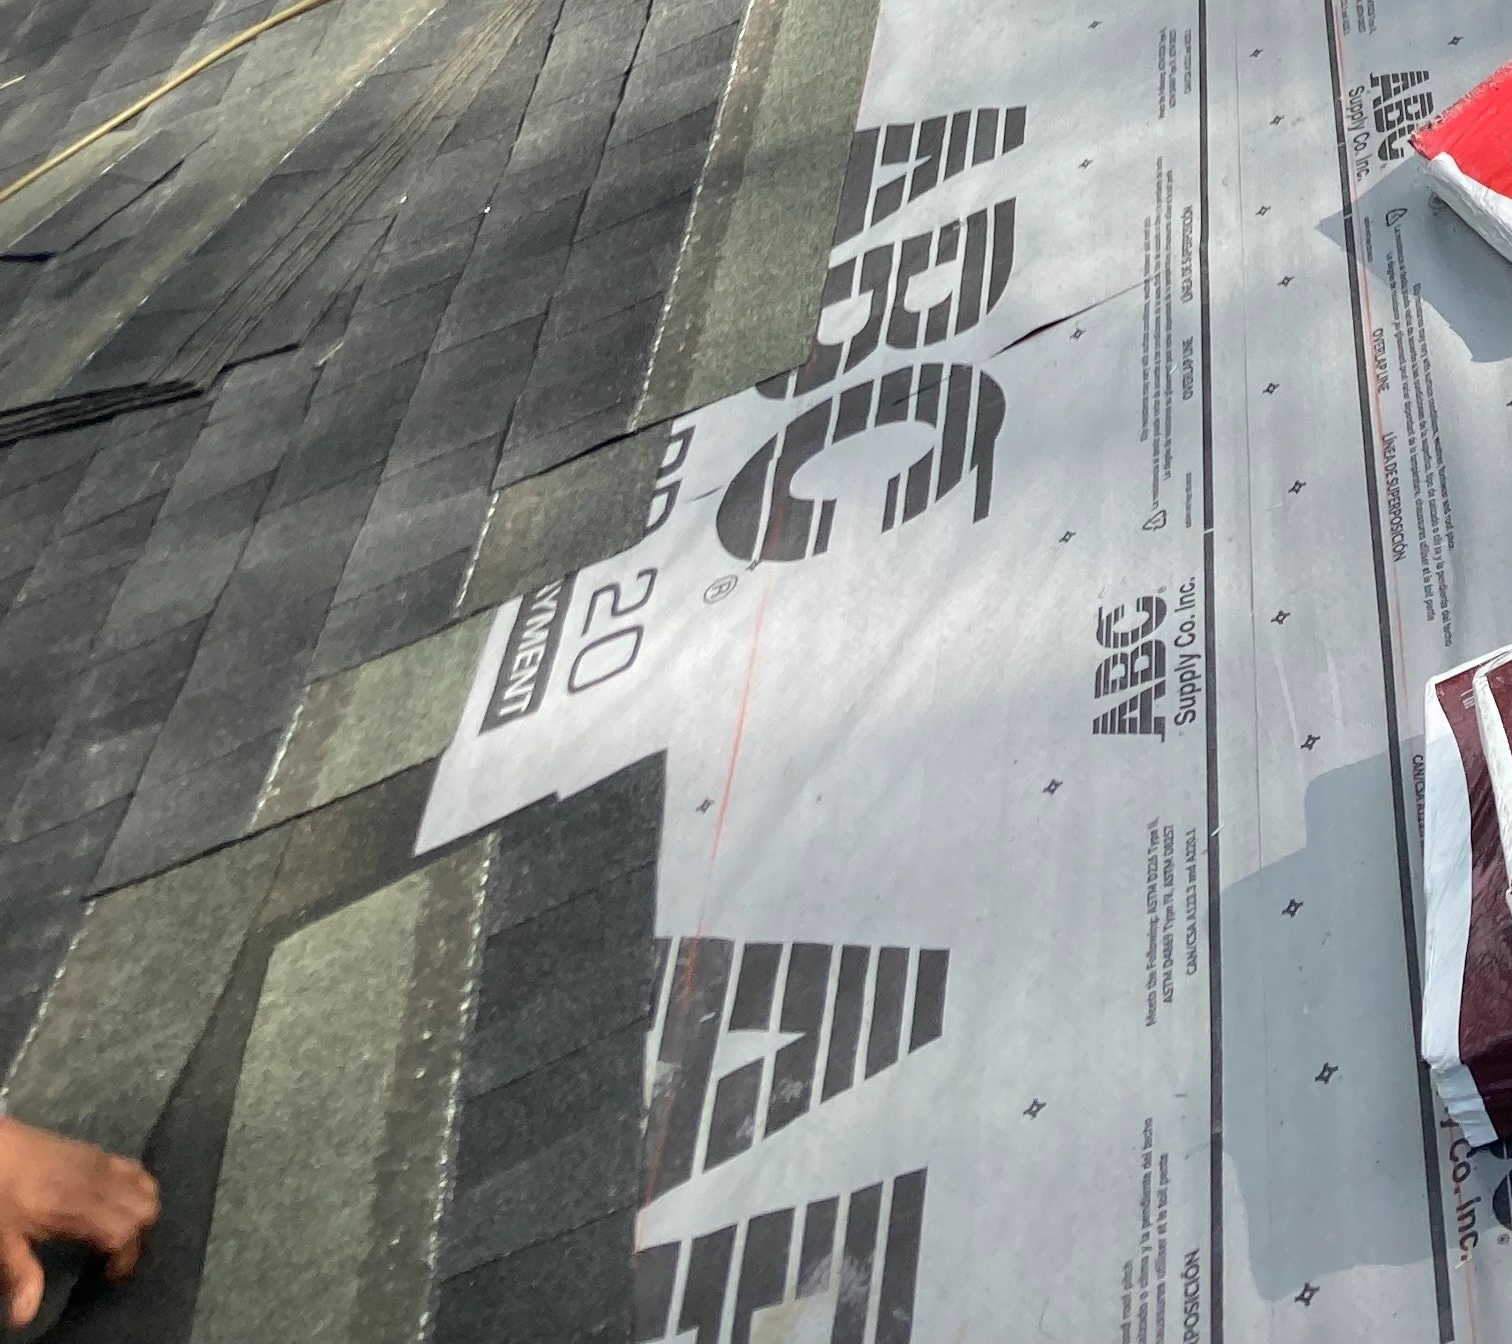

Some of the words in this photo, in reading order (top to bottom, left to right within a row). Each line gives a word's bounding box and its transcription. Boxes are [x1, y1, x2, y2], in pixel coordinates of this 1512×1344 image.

[1346, 85, 1369, 132] Supply
[1352, 131, 1371, 157] Co.
[1354, 152, 1373, 183] Inc.
[1374, 328, 1386, 372] OVERLAP
[1382, 431, 1397, 464] LÍNEA
[1389, 478, 1407, 563] SUPERPOSICIÓN
[1175, 576, 1197, 616] Inc.
[568, 566, 659, 694] 20
[1175, 619, 1197, 651] Co.
[1092, 594, 1168, 743] ABC
[1173, 653, 1202, 725] Supply
[1147, 828, 1160, 852] Type
[1163, 858, 1173, 886] ASTM
[1186, 864, 1196, 883] and
[1146, 883, 1157, 913] ASTM
[1162, 902, 1175, 932] Type
[1185, 922, 1197, 975] CAN/CSA
[1146, 972, 1157, 989] the
[1162, 970, 1173, 1003] ASTM
[1145, 991, 1157, 1025] Meets
[1448, 1137, 1473, 1195] Co.
[1453, 1202, 1480, 1263] Inc.
